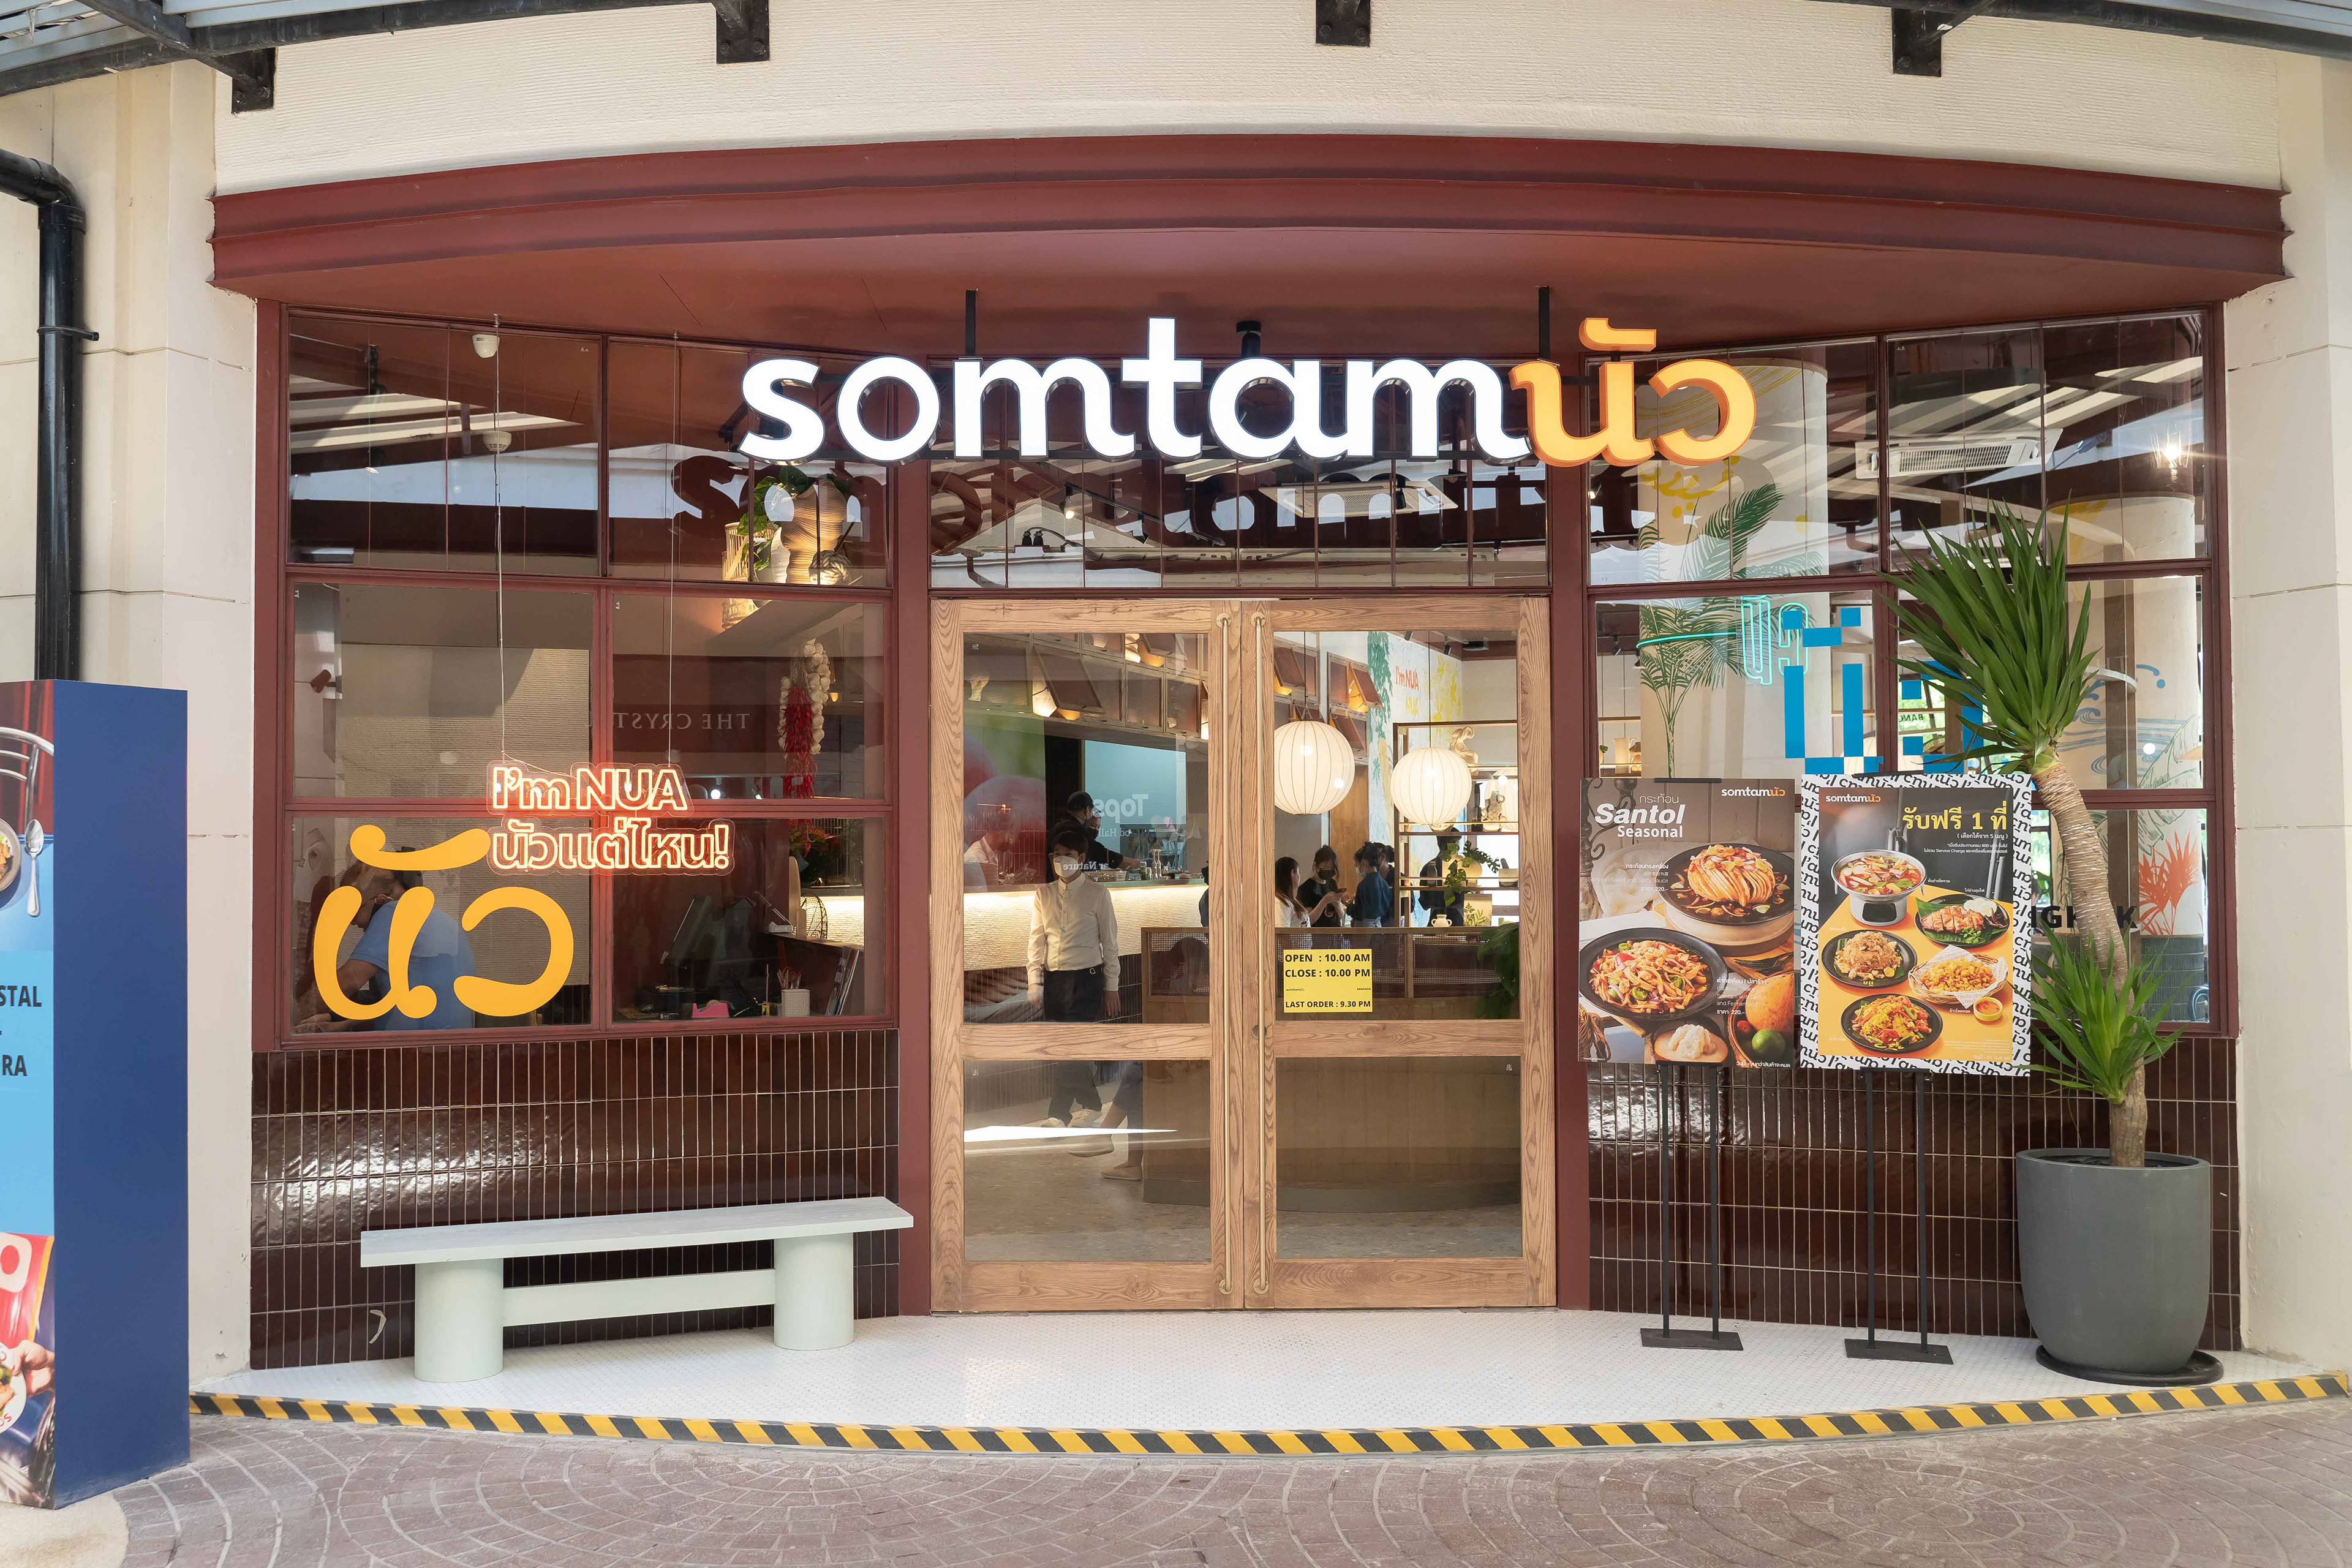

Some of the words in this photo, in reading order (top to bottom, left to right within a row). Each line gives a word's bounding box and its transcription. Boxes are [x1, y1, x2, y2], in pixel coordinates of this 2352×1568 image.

[738, 317, 1757, 467] somtamนัว
[492, 766, 570, 810] I'm
[576, 768, 688, 810] NUA
[1639, 794, 1679, 804] กระท้อน
[1595, 804, 1686, 824] Santol
[1902, 807, 1962, 831] รับฟรี
[1972, 812, 1983, 829] 1
[1991, 801, 2007, 830] ที่
[1618, 826, 1683, 838] Seasonal
[313, 824, 574, 1020] นัว
[0, 986, 42, 1007] STAL
[0, 1054, 28, 1076] RA
